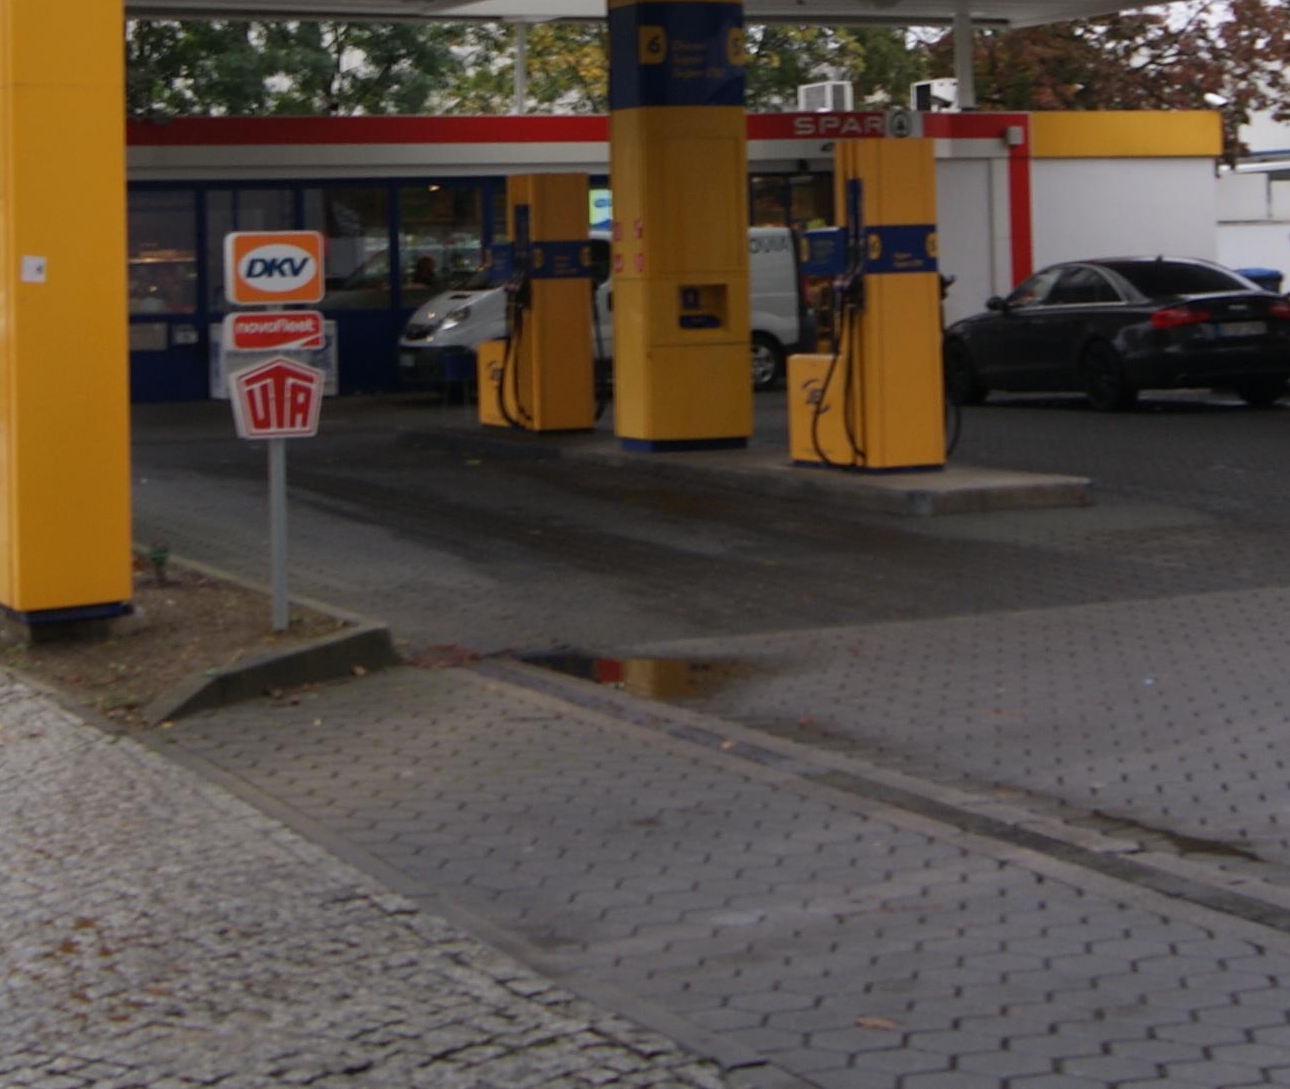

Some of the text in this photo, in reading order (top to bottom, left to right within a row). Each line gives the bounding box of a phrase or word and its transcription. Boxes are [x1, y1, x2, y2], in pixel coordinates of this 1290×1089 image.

[646, 34, 662, 54] 6
[793, 116, 885, 136] SPAR
[246, 257, 310, 279] DKV
[245, 365, 317, 430] UTA
